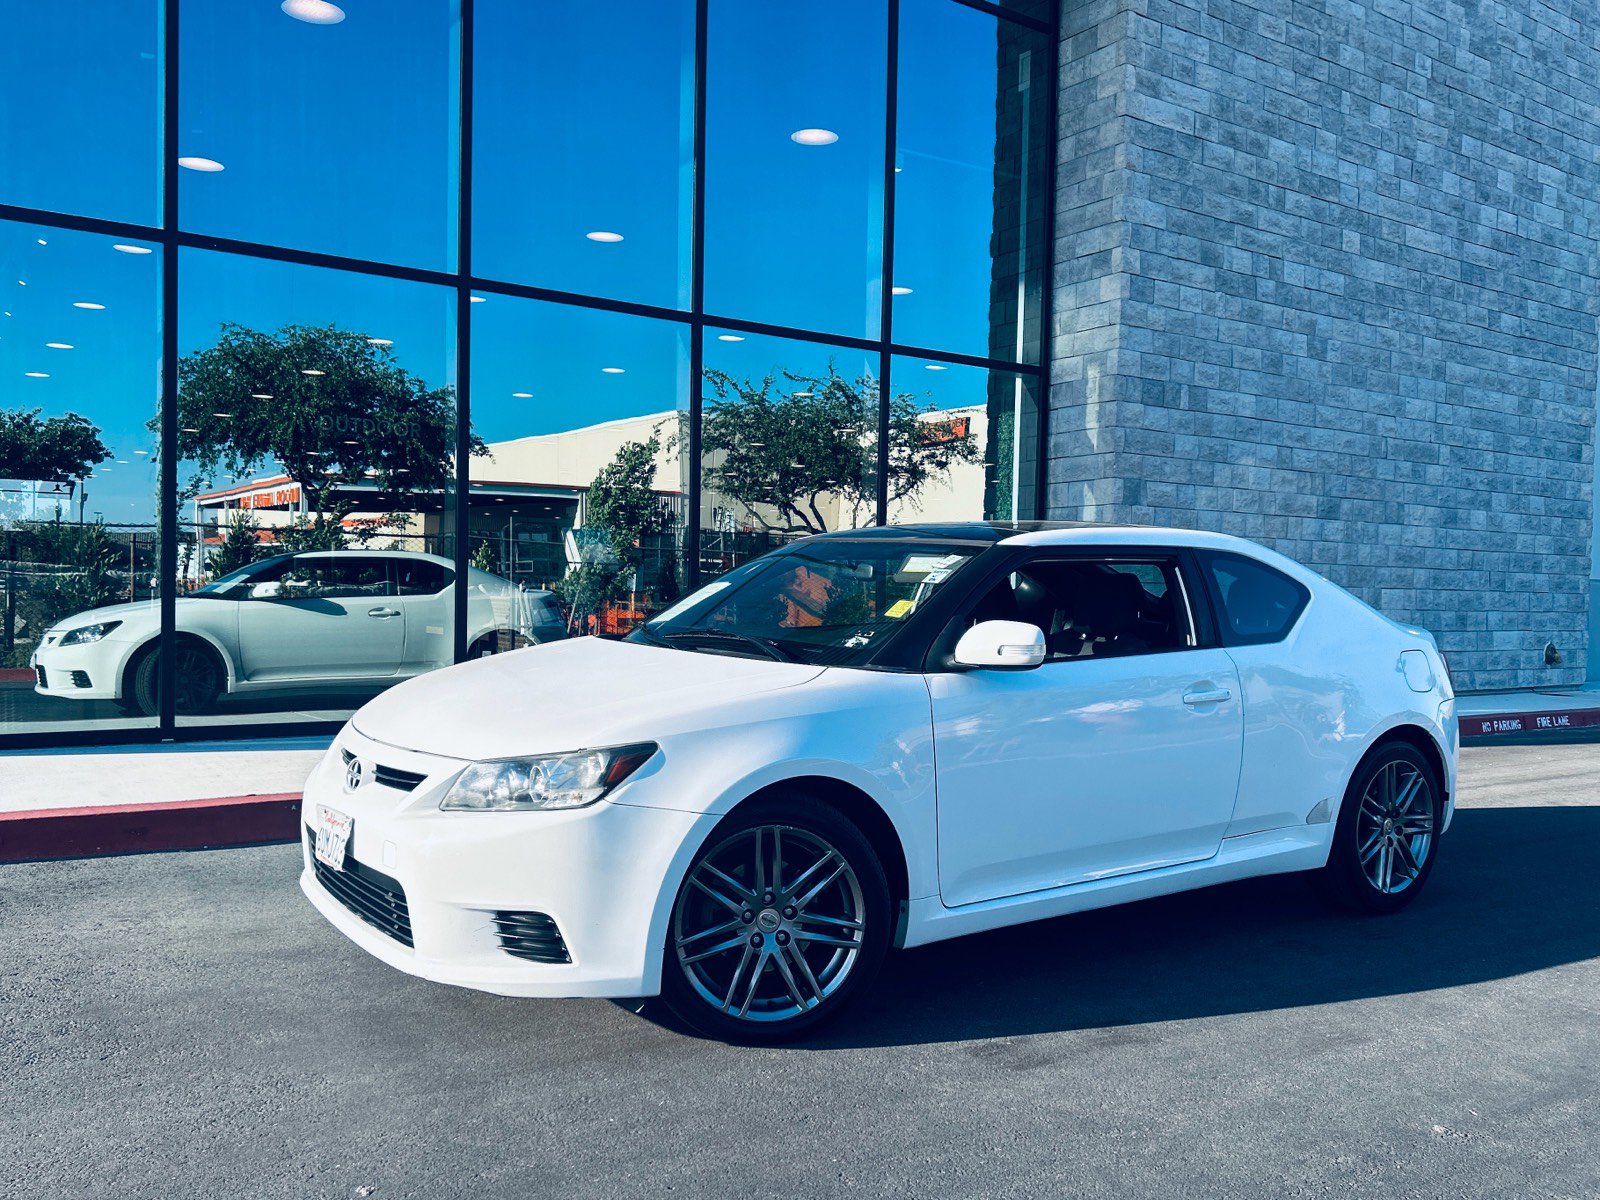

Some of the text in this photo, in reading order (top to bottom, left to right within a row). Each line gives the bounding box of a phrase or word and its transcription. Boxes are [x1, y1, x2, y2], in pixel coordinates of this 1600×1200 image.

[319, 415, 420, 437] OUTDOOR
[1481, 715, 1570, 732] NO PARKING FIRE LANE
